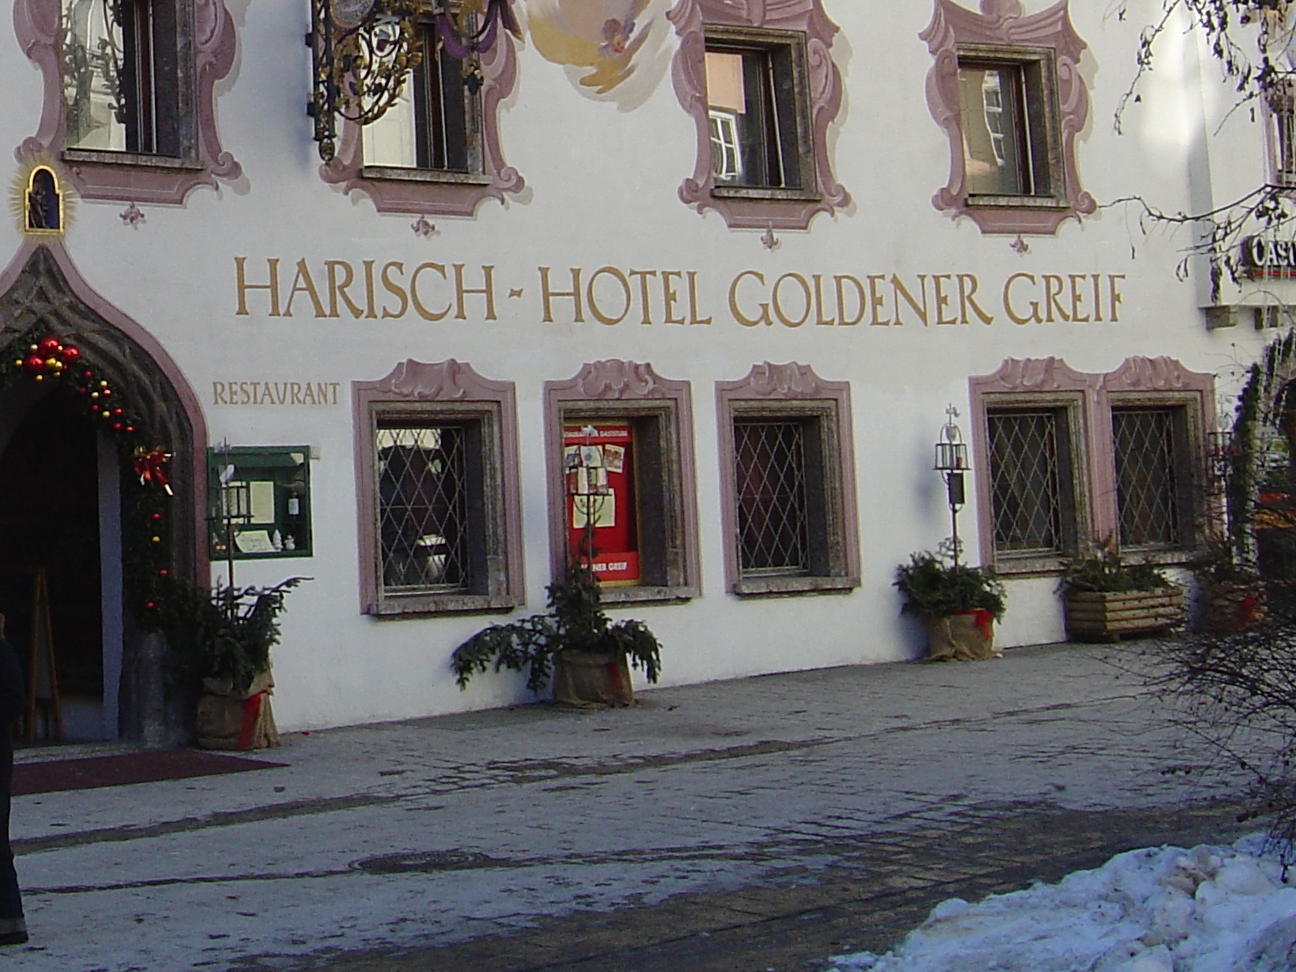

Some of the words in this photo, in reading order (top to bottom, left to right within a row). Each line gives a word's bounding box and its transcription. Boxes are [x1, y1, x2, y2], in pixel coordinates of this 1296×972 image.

[234, 256, 499, 322] HARISCH
[537, 266, 713, 326] HOTEL
[727, 270, 994, 328] GOLDENER
[1003, 272, 1126, 326] GREIF
[212, 381, 341, 406] RESTAURANT
